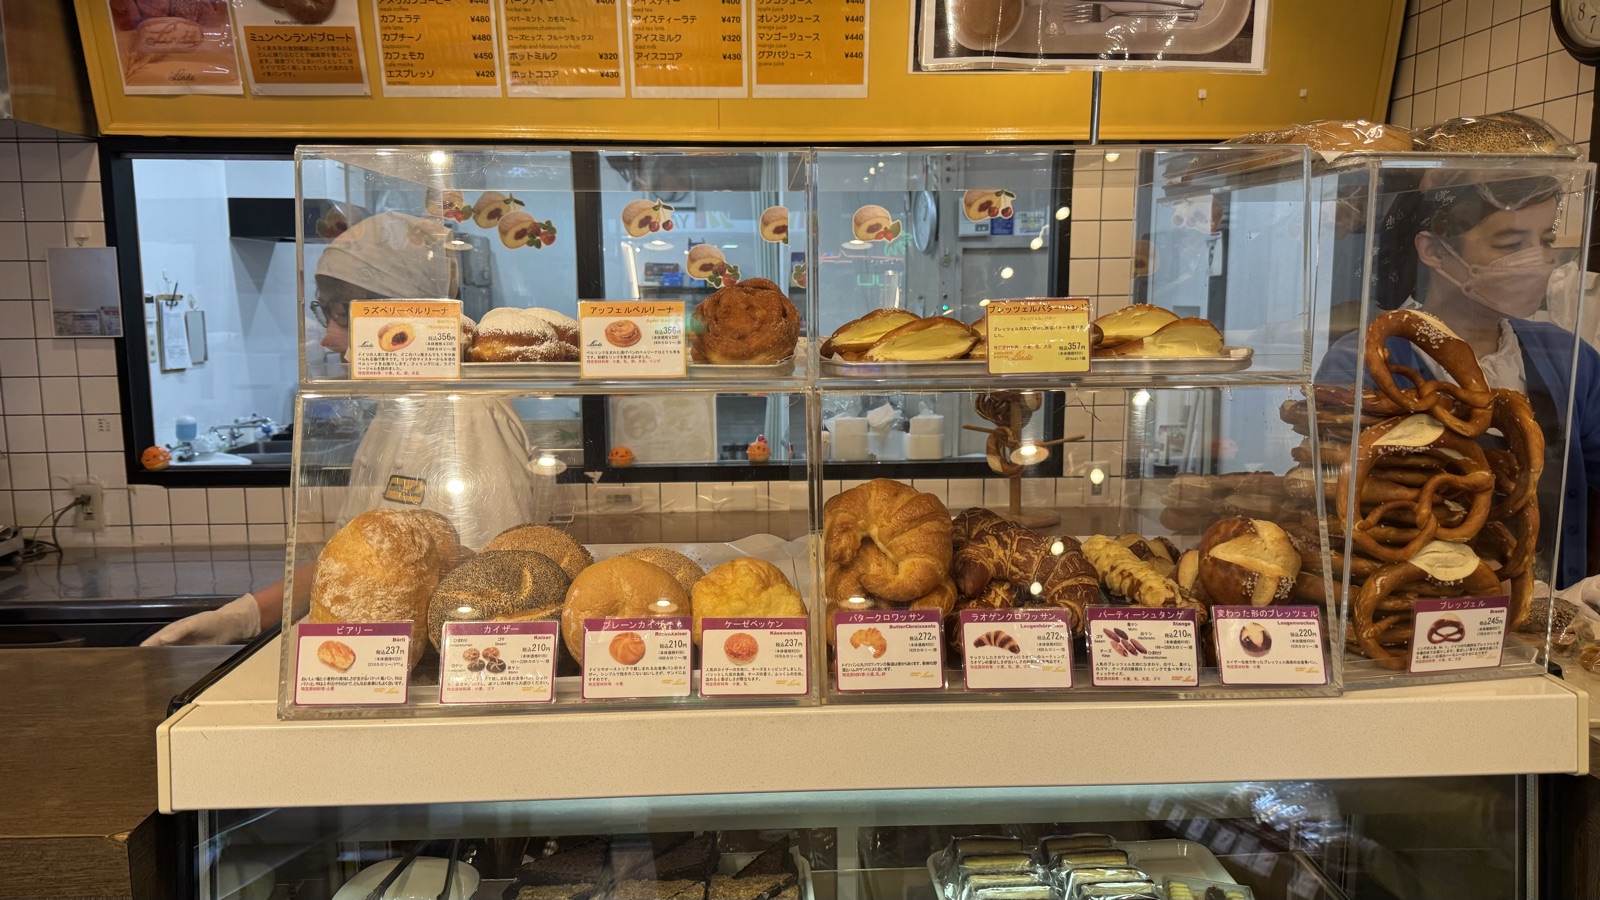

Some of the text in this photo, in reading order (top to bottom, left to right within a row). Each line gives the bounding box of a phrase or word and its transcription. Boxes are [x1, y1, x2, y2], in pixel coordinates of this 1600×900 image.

[1578, 3, 1585, 20] 8
[380, 15, 420, 23] カフェラテ
[634, 16, 697, 24] アイスティーラテ
[758, 15, 820, 23] オレンジジュース
[1590, 15, 1597, 33] 7
[250, 33, 352, 42] ミュンヘンランドブロート
[634, 34, 682, 42] アイスミルク
[758, 33, 820, 41] マンゴージュース
[384, 52, 424, 60] カフェモカ
[509, 52, 557, 60] ホットミルク
[635, 52, 682, 60] アイスココア
[758, 51, 812, 59] グアバジュース
[169, 69, 195, 80] Linde
[387, 70, 434, 78] エスプレッソ
[511, 71, 559, 79] ホットココア
[362, 306, 448, 314] ラズベリーベルリーナ
[590, 306, 674, 314] アッフェルベルリーナ
[428, 333, 456, 341] 税込356円
[1059, 342, 1086, 351] 税込357円
[1008, 350, 1033, 361] Linde
[1440, 600, 1486, 610] プレッツェル
[971, 613, 1056, 621] ラオゲンクロワッサン
[1099, 610, 1185, 619] パーティーシュタンゲ
[1217, 609, 1318, 618] 変わった形のプレッツェル
[849, 614, 924, 622] バタークロワッサン
[1479, 617, 1503, 626] 税込245円
[725, 620, 783, 628] ケーゼベッケン
[336, 626, 373, 635] ビアリー
[483, 625, 519, 634] カイザー
[1290, 629, 1317, 637] 税込220円
[910, 632, 936, 641] 税込272円
[1037, 632, 1064, 640] 税込272円
[1164, 630, 1192, 638] 税込210円
[660, 640, 687, 648] 税込210円
[776, 639, 802, 647] 税込237円
[376, 646, 404, 655] 税込237円
[522, 644, 550, 652] 税込210円
